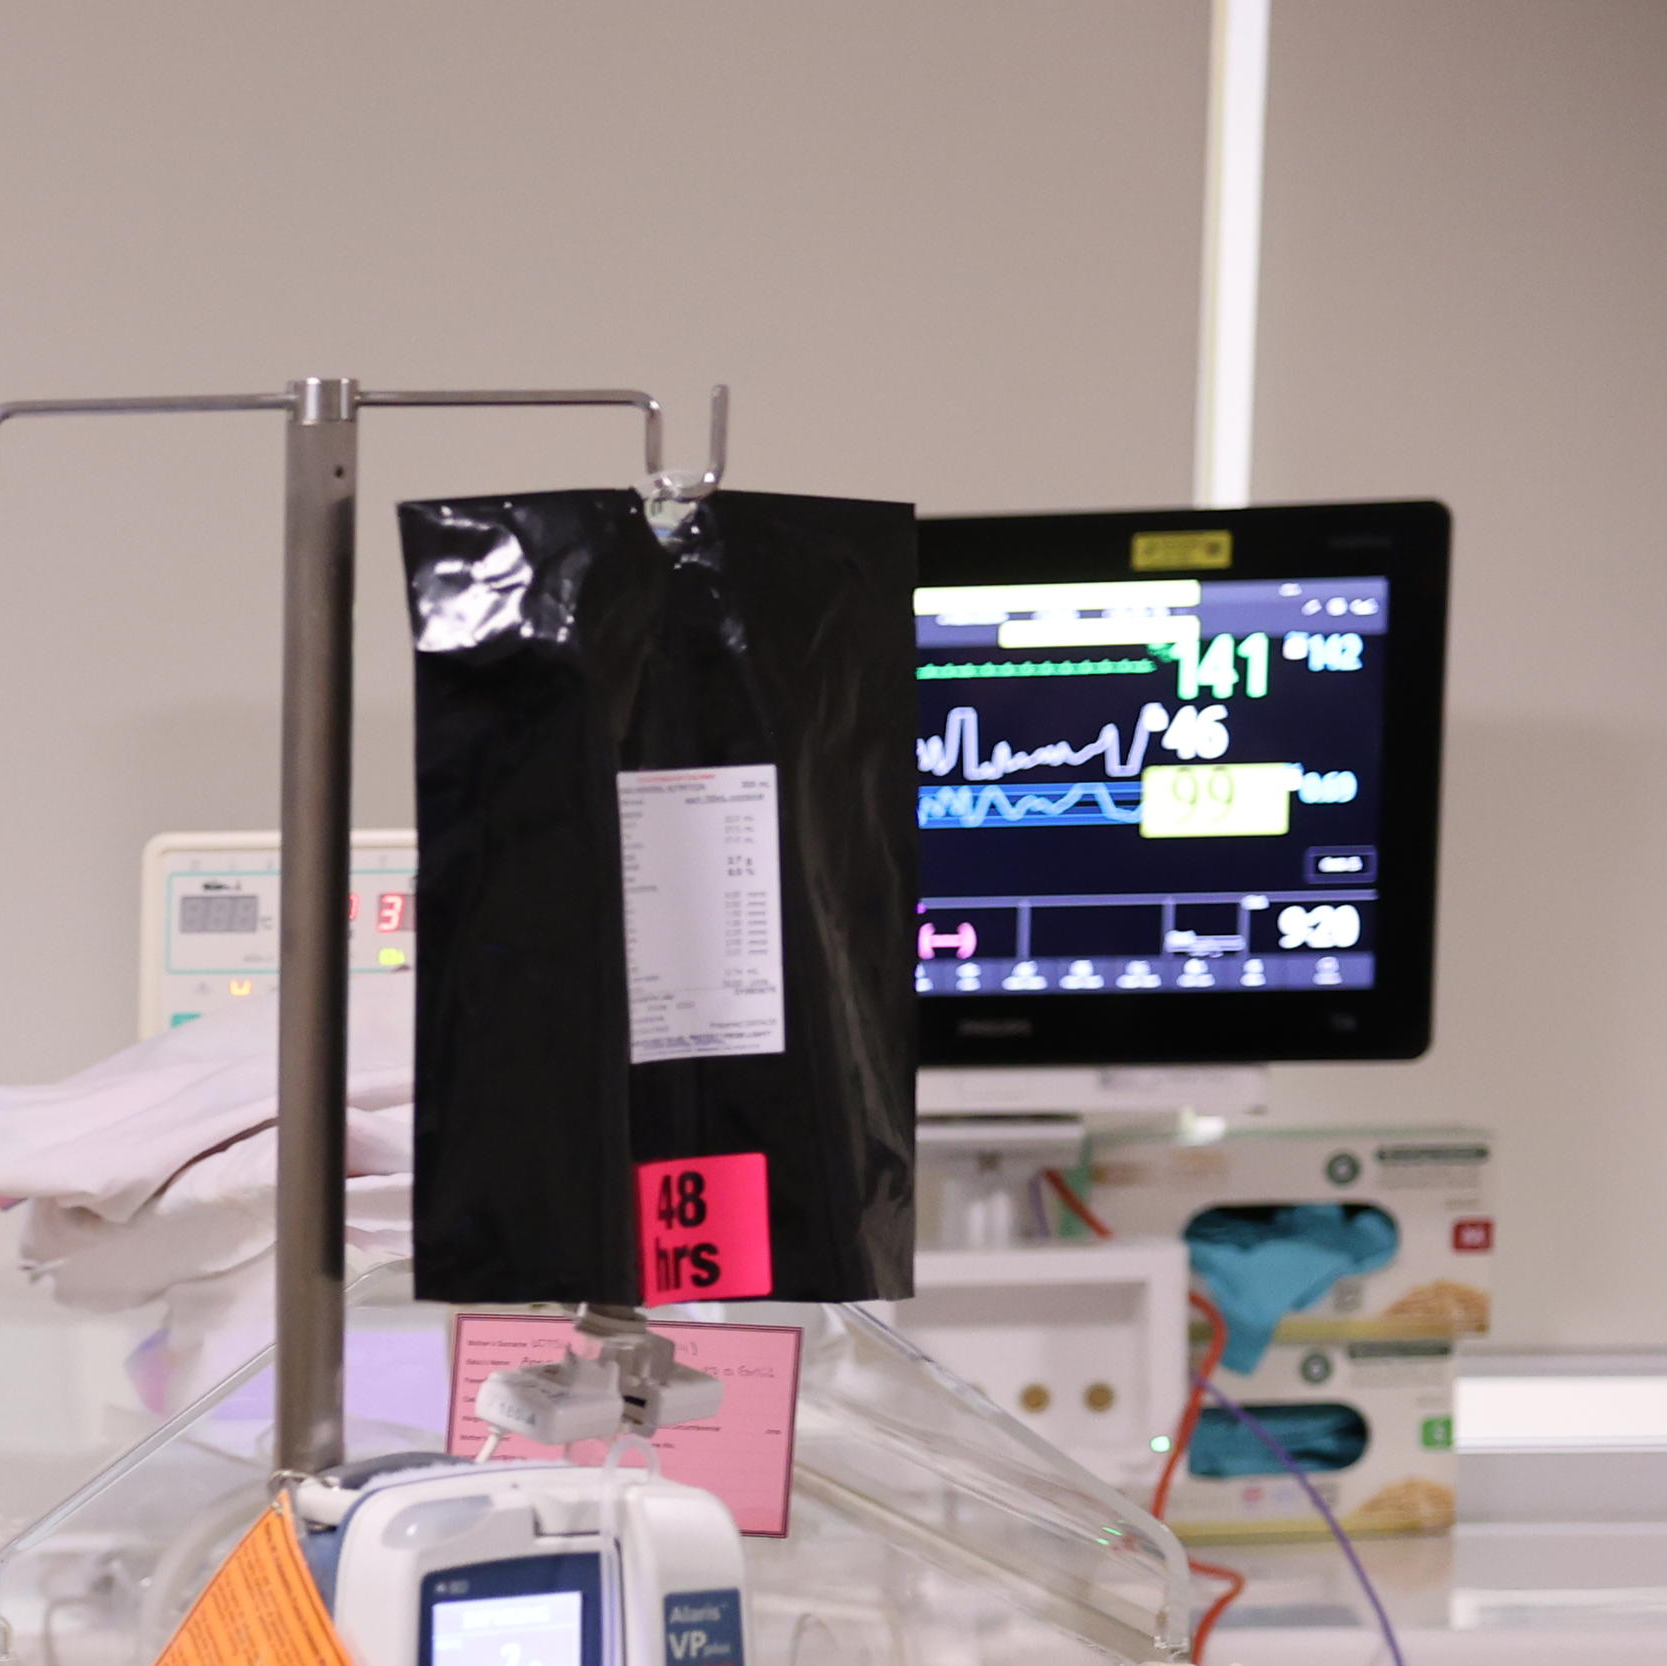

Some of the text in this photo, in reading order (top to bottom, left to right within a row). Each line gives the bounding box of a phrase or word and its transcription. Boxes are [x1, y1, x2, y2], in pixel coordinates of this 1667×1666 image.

[1172, 631, 1269, 700] 141
[1161, 703, 1229, 760] 46
[1171, 764, 1236, 826] 99
[657, 1171, 707, 1230] 48
[655, 1237, 721, 1292] hrs
[670, 1605, 721, 1624] Alaris
[669, 1630, 708, 1661] VP
